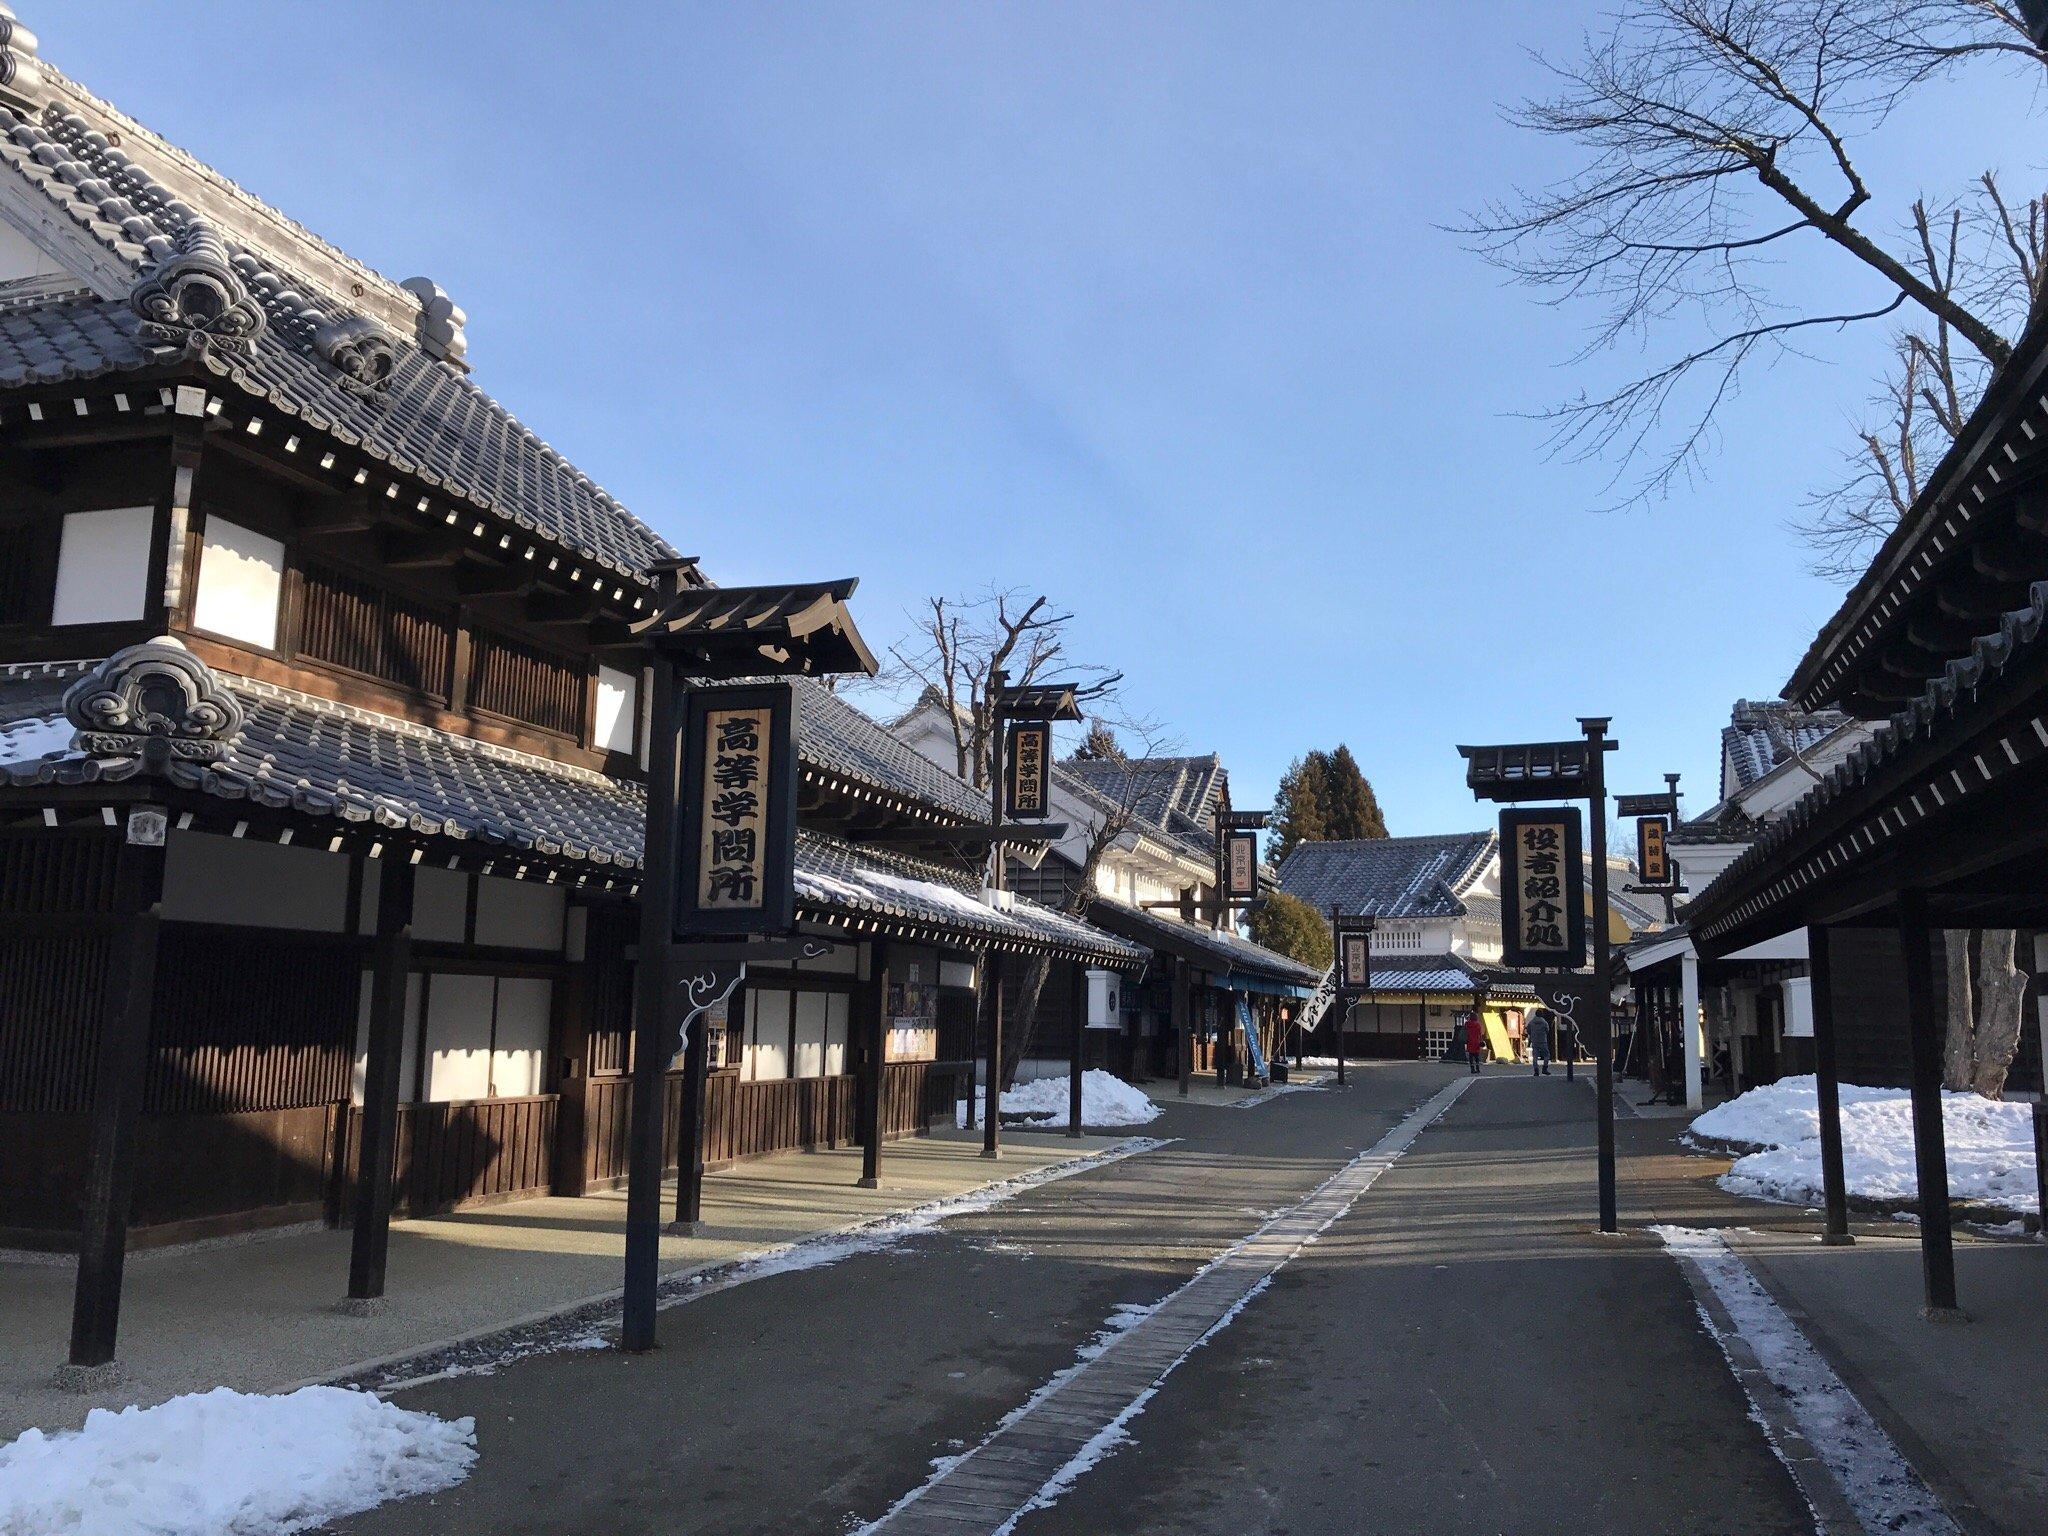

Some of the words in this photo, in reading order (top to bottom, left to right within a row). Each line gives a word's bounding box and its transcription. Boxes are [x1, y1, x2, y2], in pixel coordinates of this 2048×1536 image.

[707, 717, 761, 902] 高等学問所
[1017, 733, 1039, 809] 高等学問所
